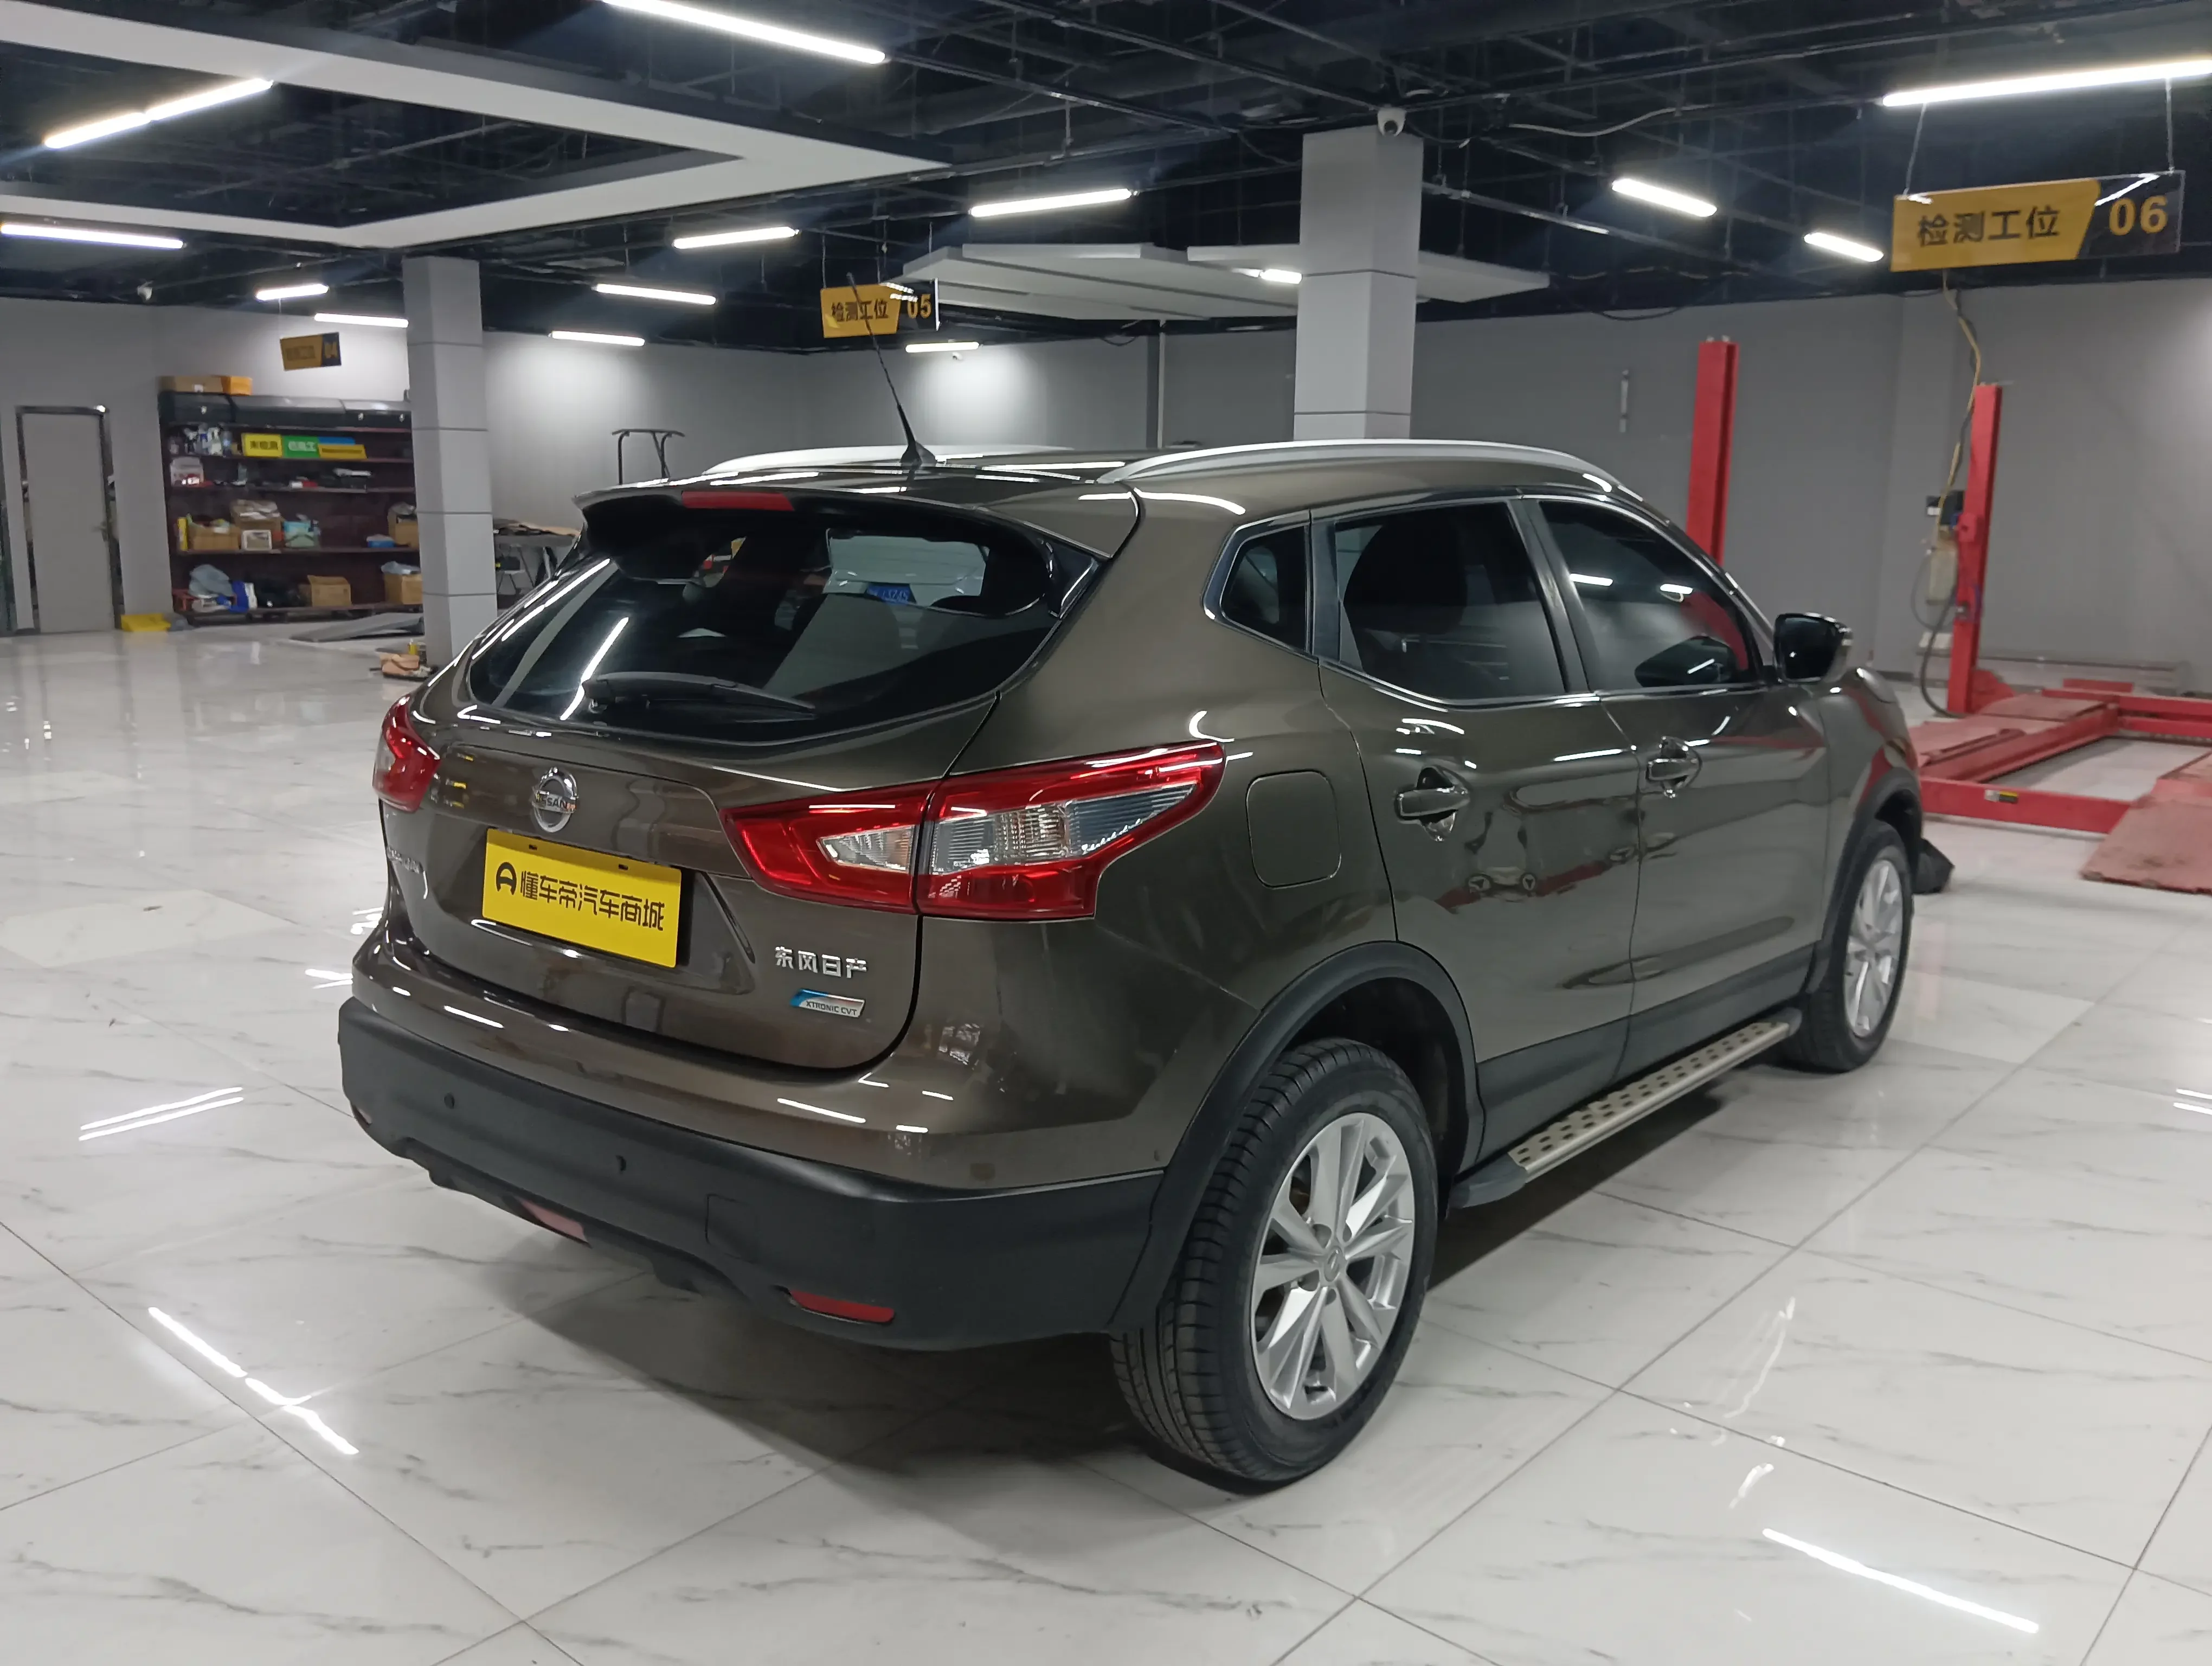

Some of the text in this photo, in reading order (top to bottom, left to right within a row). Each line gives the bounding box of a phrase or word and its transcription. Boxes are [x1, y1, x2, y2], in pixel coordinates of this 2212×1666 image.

[1917, 195, 2168, 247] 检测工位 06
[907, 293, 932, 319] 05
[520, 869, 665, 932] 懂车帝汽车商城
[775, 946, 867, 978] 东风日产
[806, 1001, 857, 1016] XTRONIC CVT
